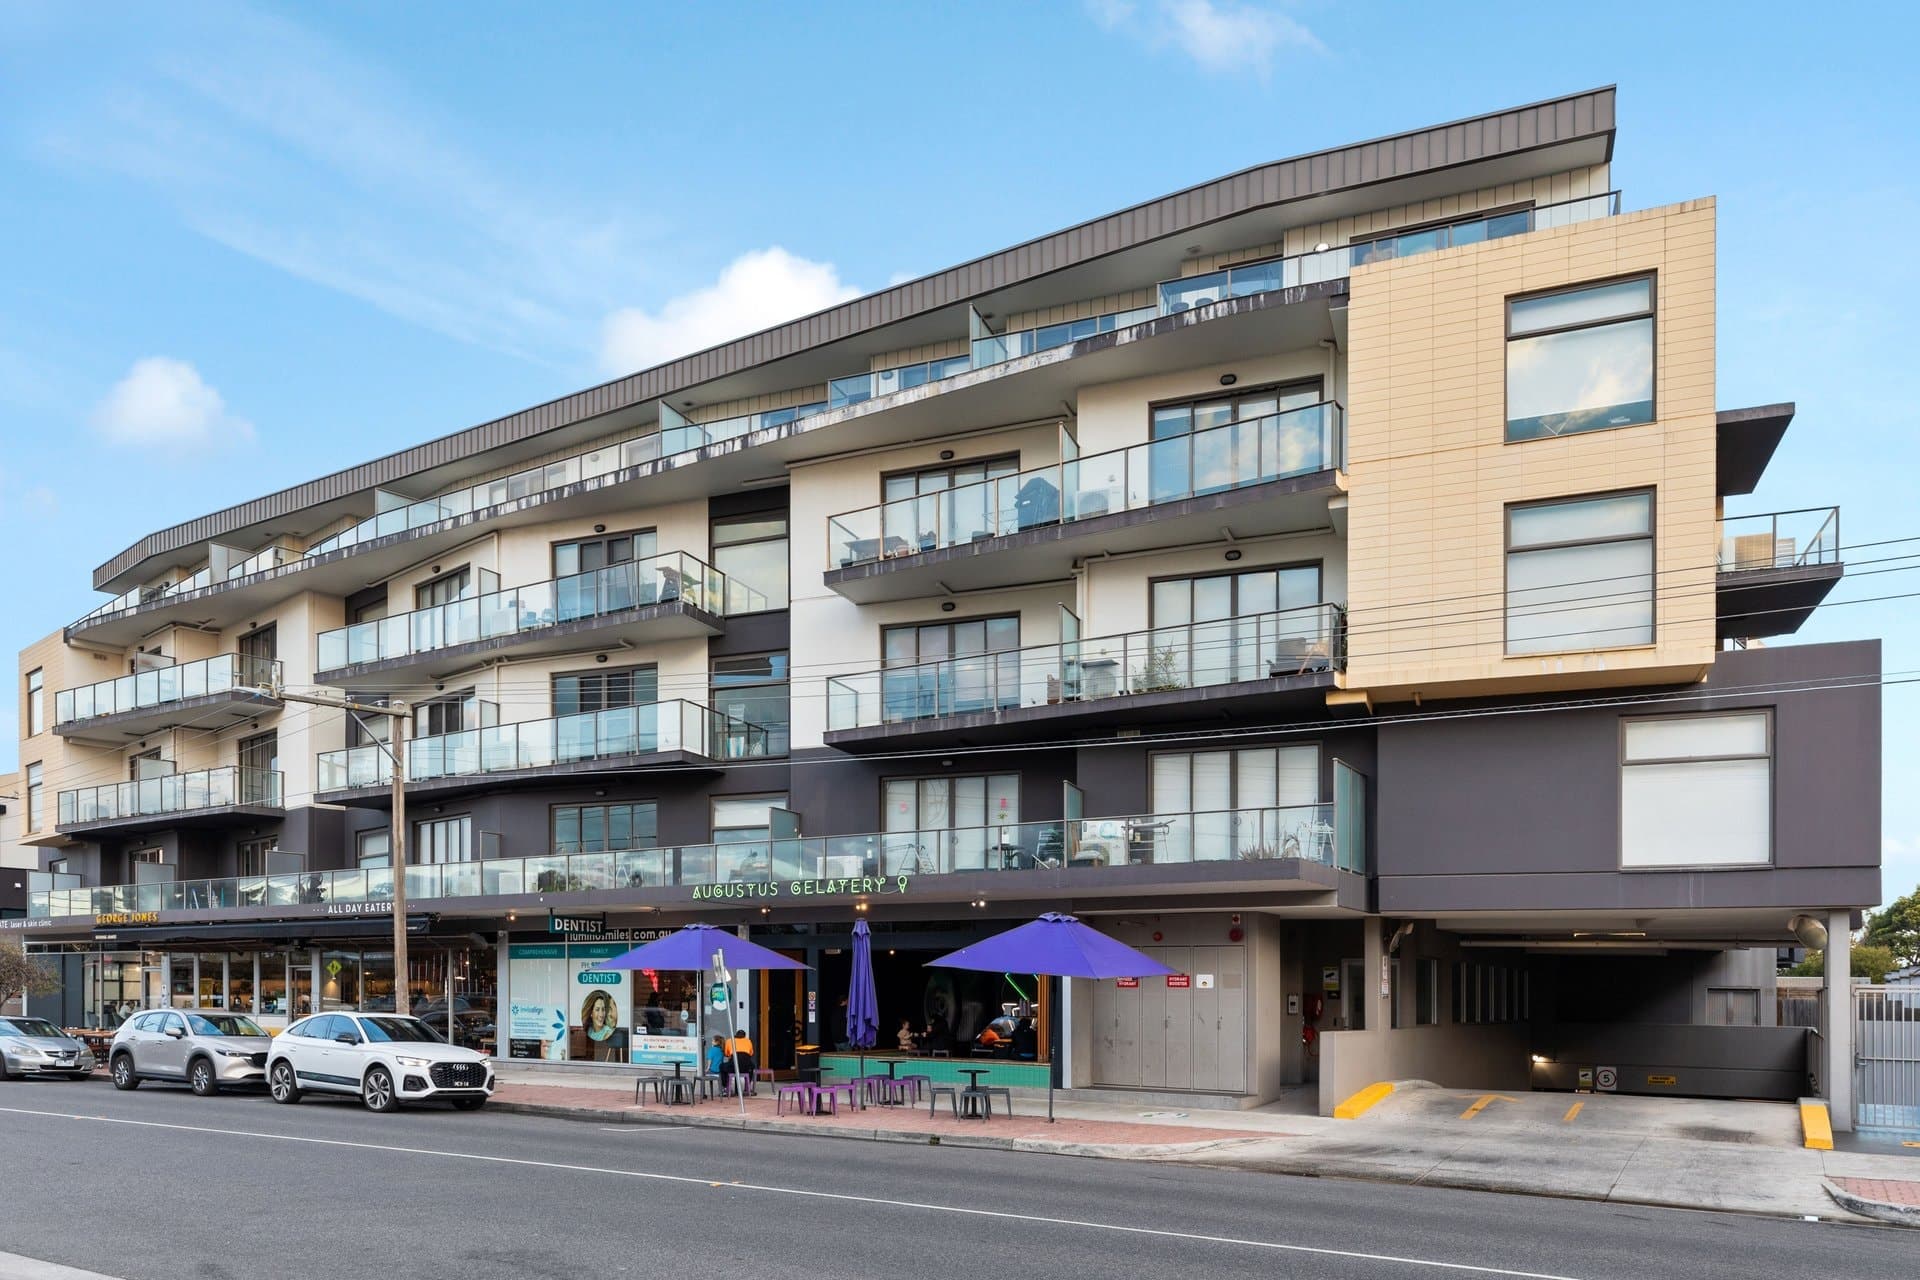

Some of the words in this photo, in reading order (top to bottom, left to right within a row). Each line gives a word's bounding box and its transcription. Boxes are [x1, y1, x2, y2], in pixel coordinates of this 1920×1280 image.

[692, 881, 778, 899] AUGUSTUS
[790, 877, 886, 895] GELATERY
[328, 905, 343, 914] ALL
[345, 903, 362, 913] DAY
[96, 912, 128, 924] GEORGE
[131, 911, 158, 923] JONES
[555, 918, 603, 932] DENTIST
[582, 973, 617, 983] DENTIST
[1603, 1074, 1610, 1083] 5
